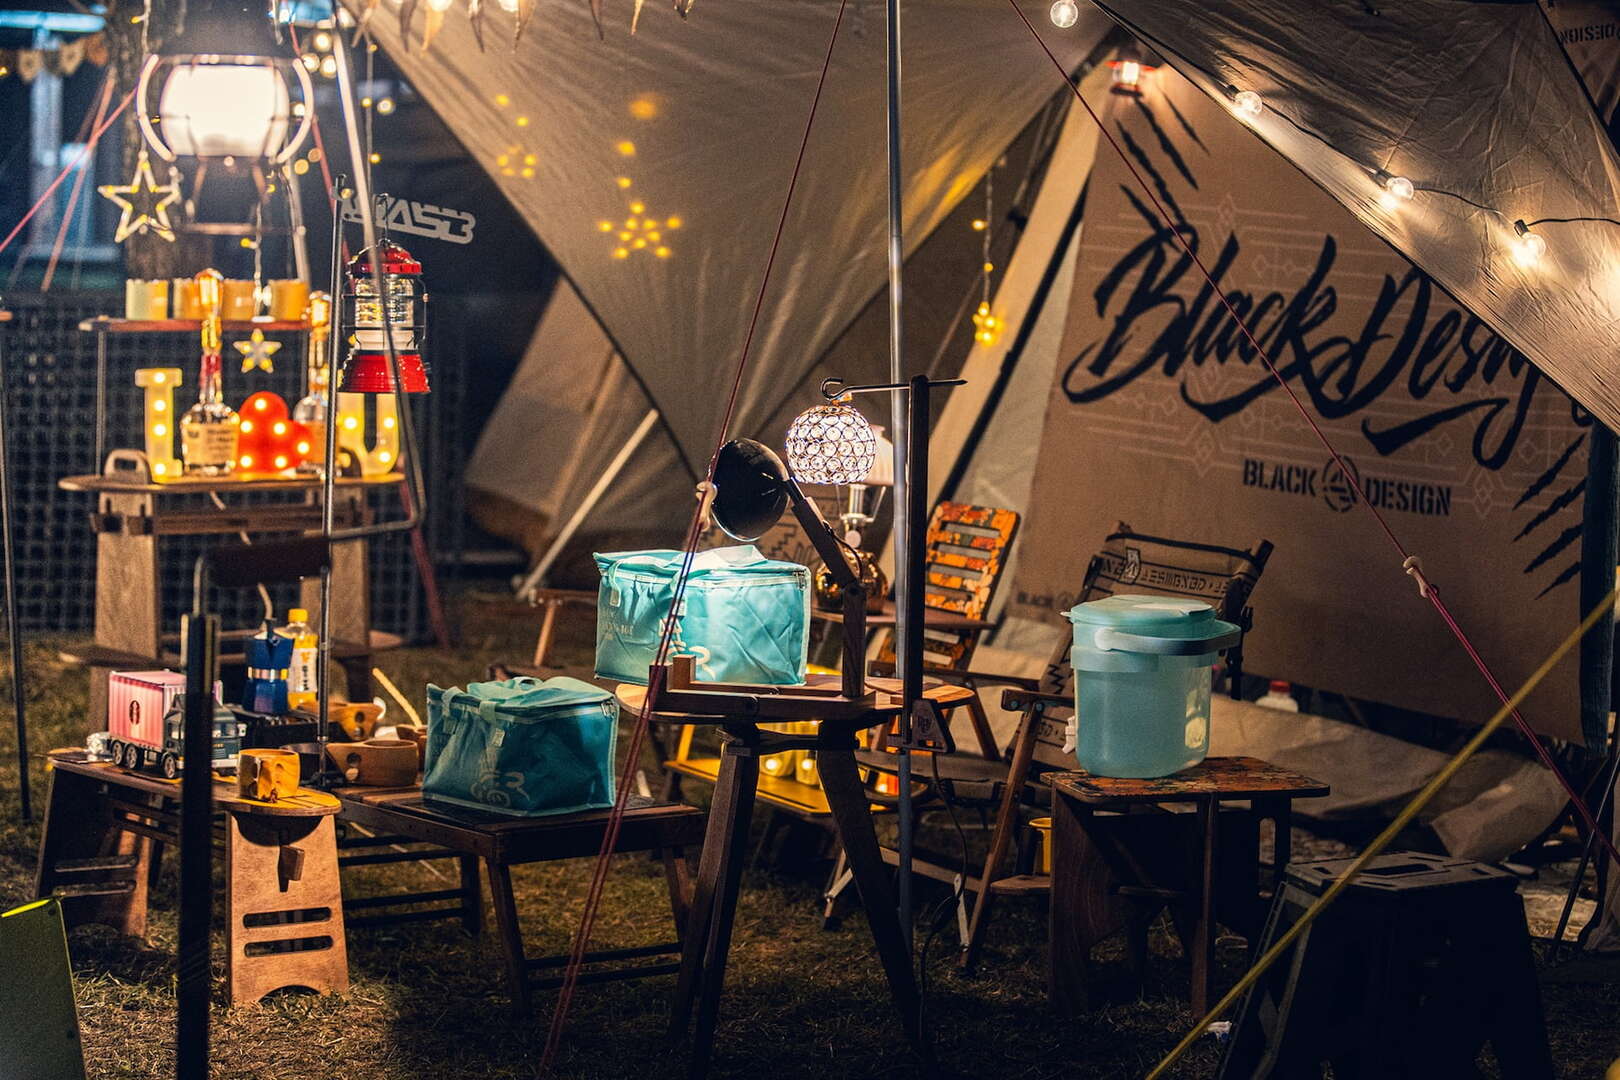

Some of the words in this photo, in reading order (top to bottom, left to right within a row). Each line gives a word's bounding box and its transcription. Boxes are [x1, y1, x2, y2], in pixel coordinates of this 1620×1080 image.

[1061, 222, 1337, 422] Black
[1243, 459, 1317, 497] BLACK
[1364, 477, 1450, 516] DESIGN
